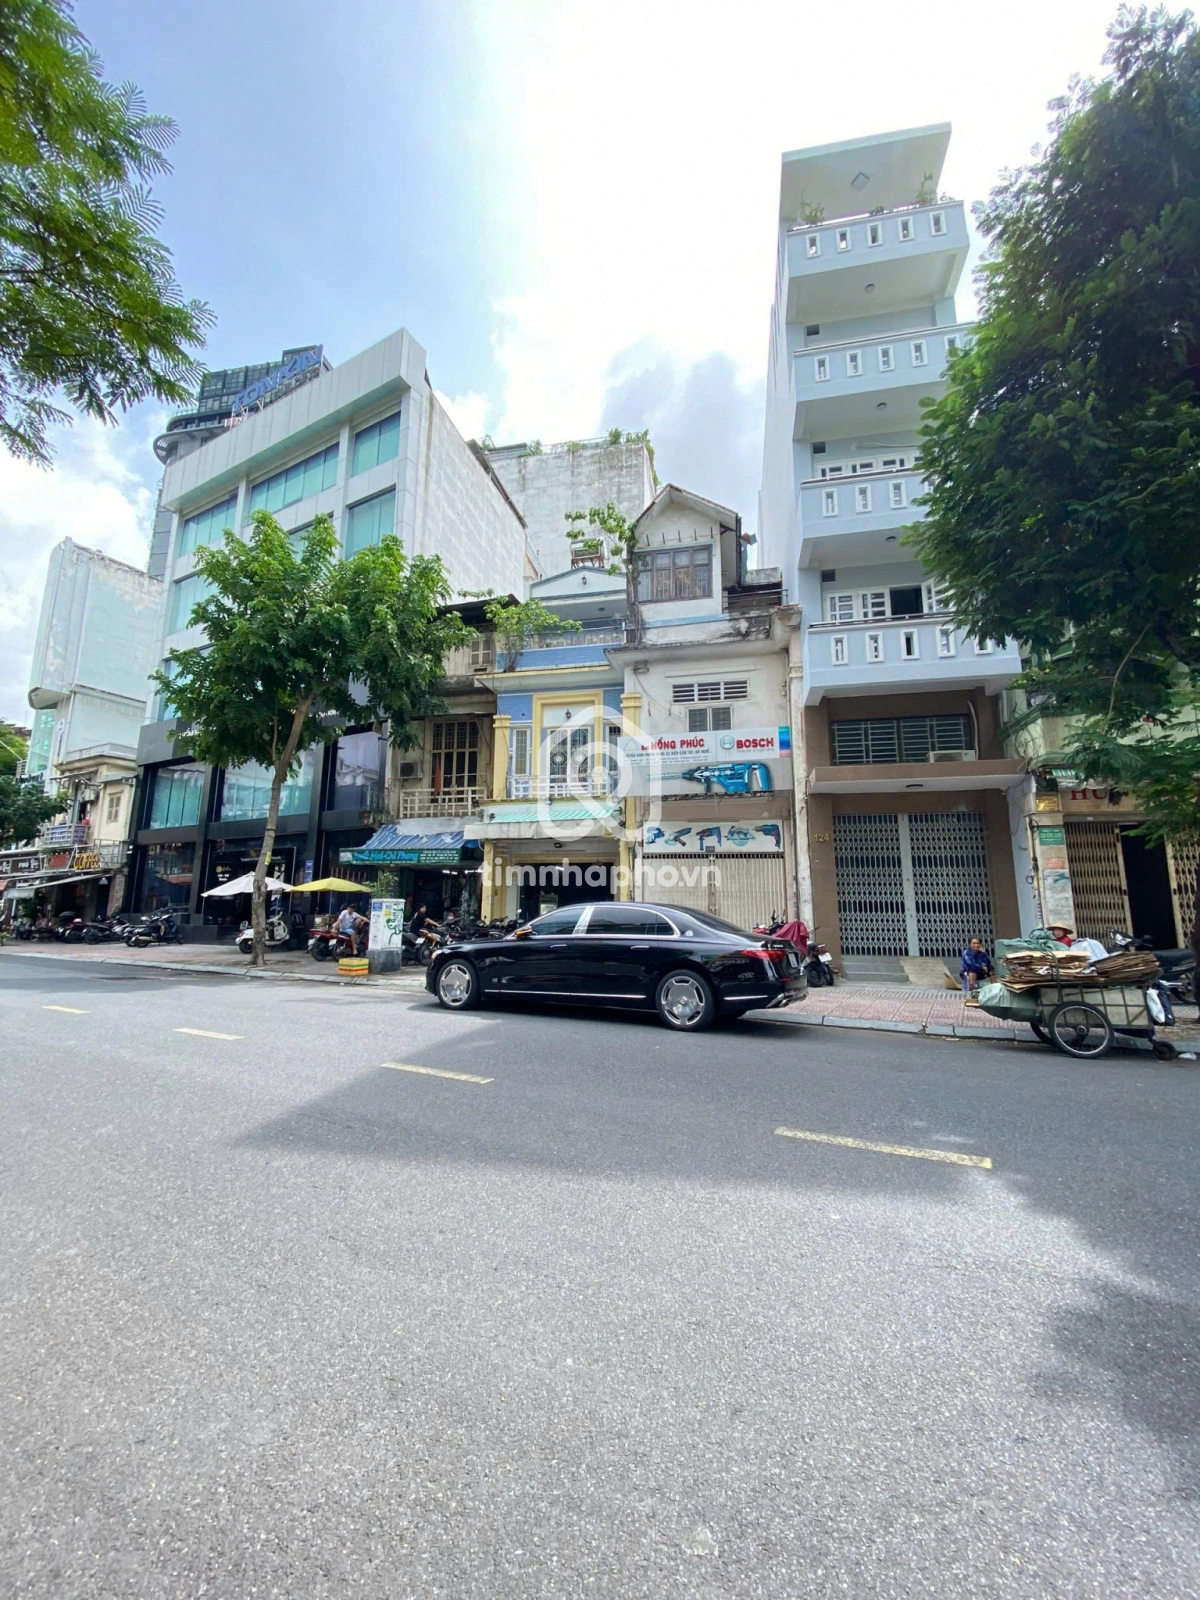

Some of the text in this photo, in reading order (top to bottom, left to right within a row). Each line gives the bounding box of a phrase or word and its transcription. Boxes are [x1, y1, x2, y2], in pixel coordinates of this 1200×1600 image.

[680, 736, 705, 748] PHÚC
[736, 737, 774, 749] BOSCH
[814, 833, 830, 842] 124
[73, 853, 99, 870] COFFEE
